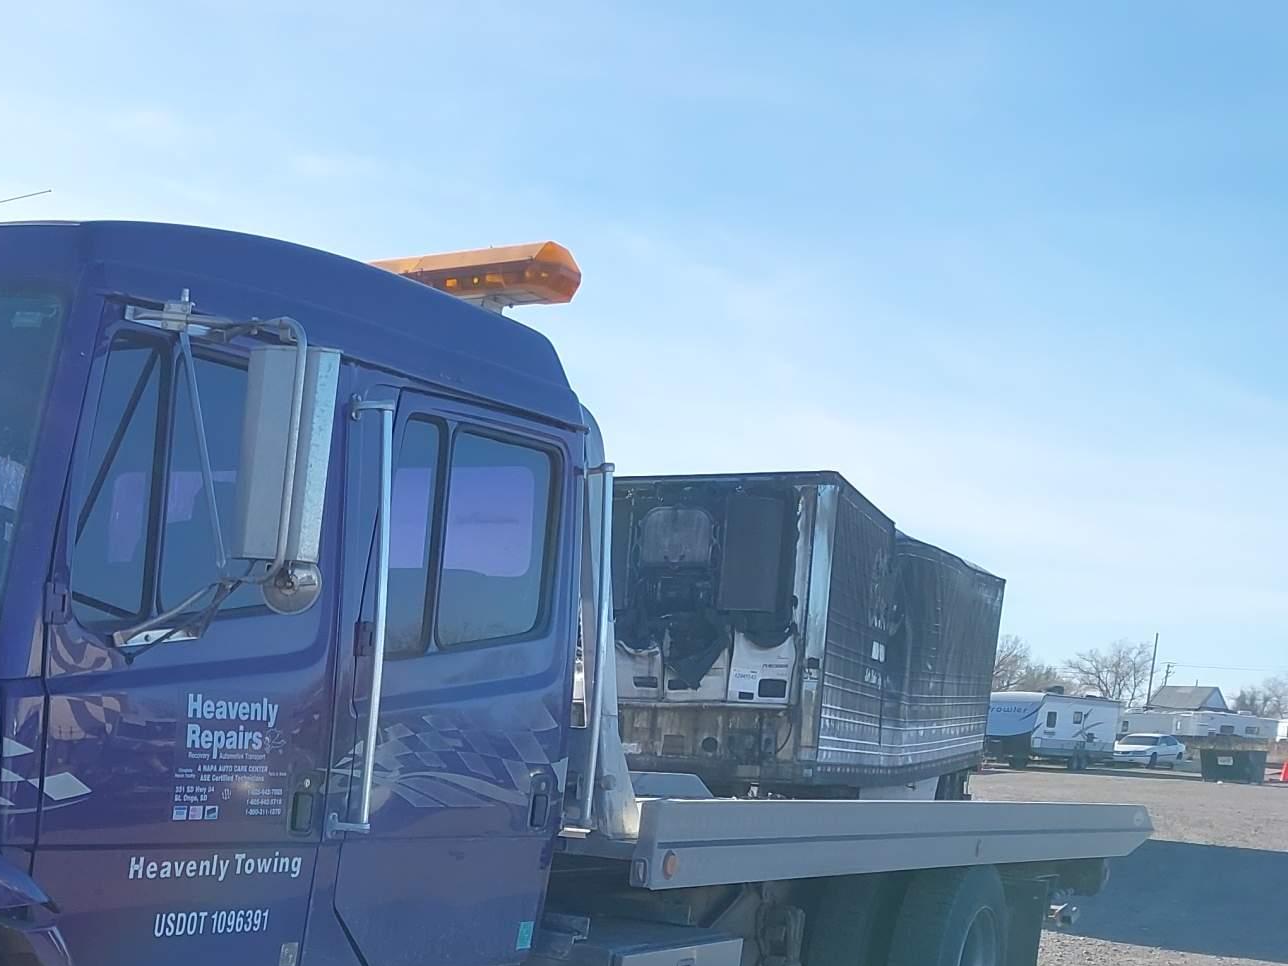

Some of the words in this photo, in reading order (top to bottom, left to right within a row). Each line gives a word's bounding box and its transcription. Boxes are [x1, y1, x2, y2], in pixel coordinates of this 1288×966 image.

[187, 693, 279, 727] Heavenly
[990, 705, 1028, 713] rowler
[186, 724, 263, 759] Repairs
[128, 854, 229, 882] Heavenly
[234, 851, 302, 877] Towing
[154, 911, 208, 937] USDOT
[211, 909, 269, 933] 1096391
